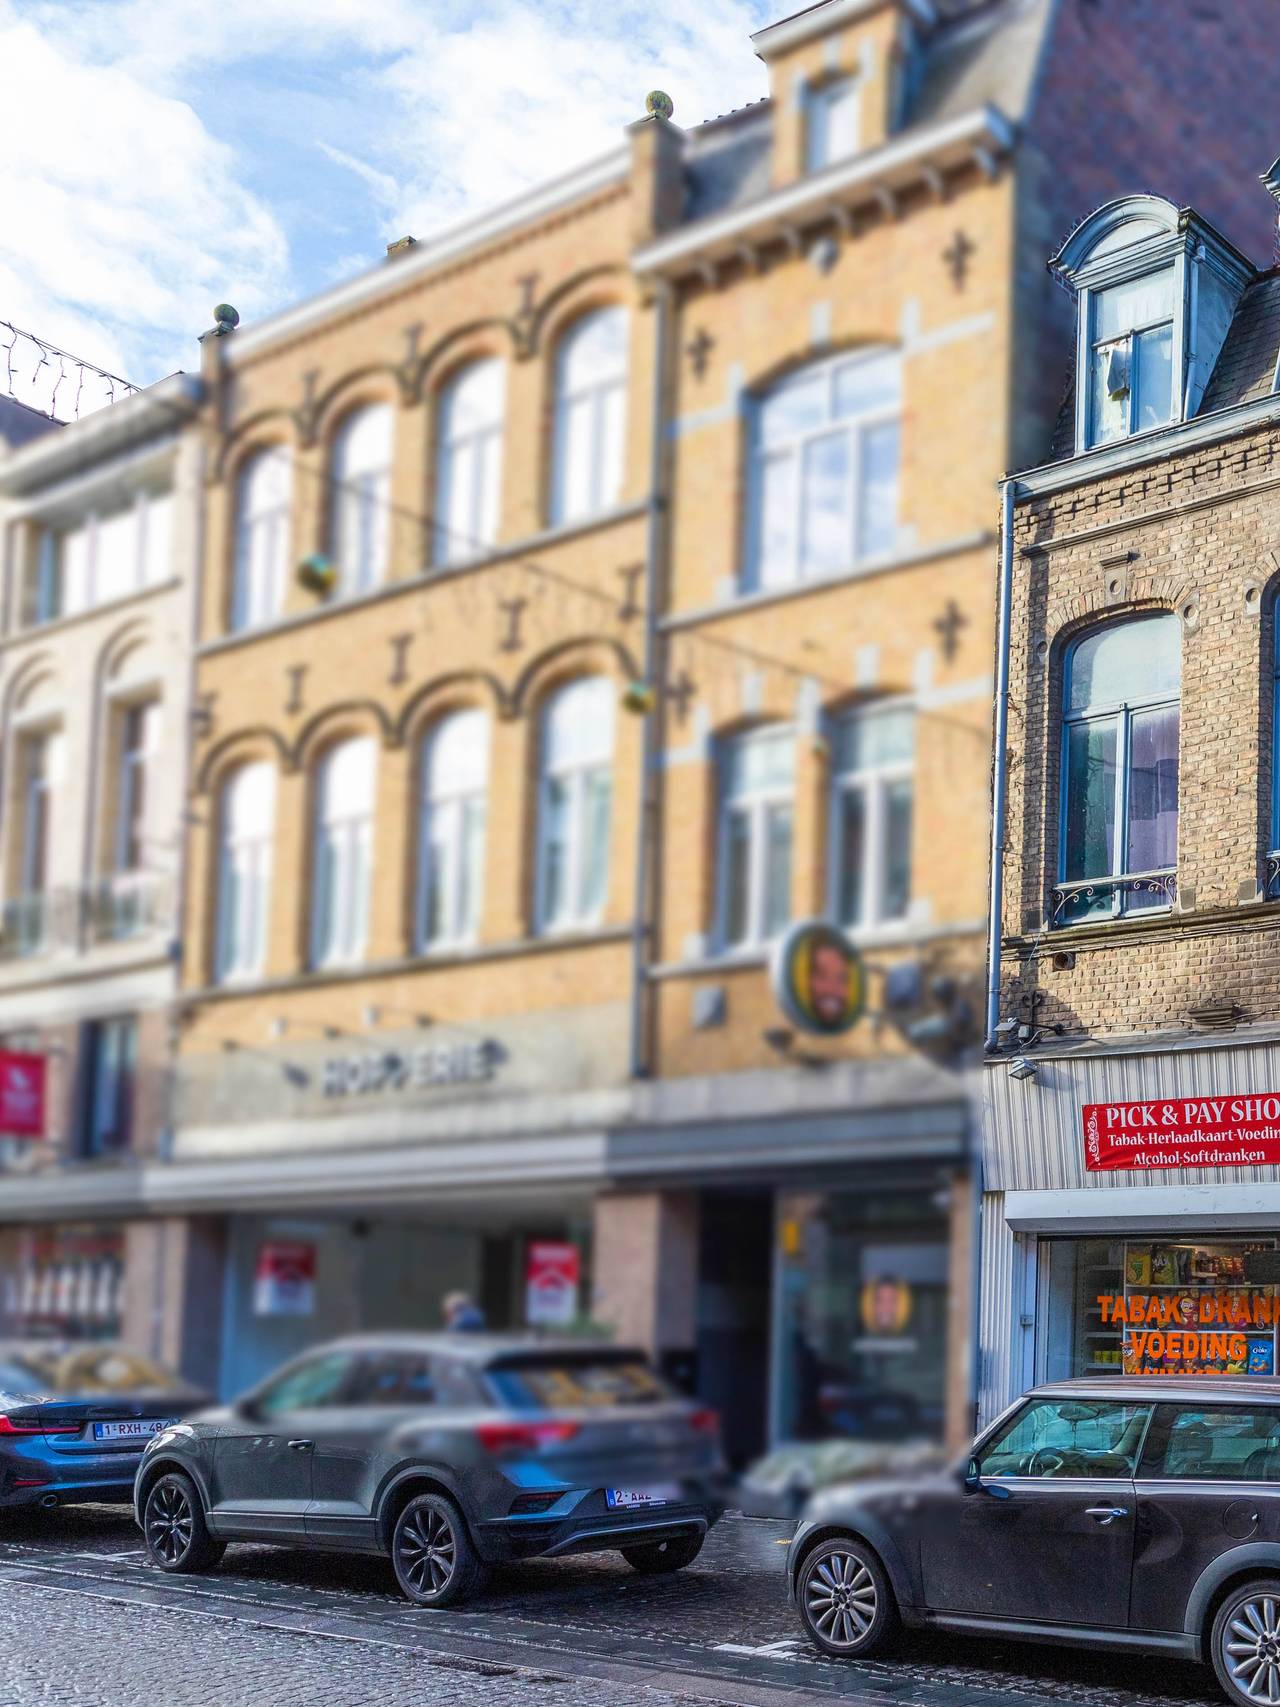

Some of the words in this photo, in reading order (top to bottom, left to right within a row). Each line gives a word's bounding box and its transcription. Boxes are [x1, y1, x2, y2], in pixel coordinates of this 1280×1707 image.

[1106, 1103, 1157, 1129] PICK
[1161, 1104, 1179, 1126] &
[1184, 1101, 1229, 1125] PAY
[1133, 1148, 1266, 1166] Alcohol-Softdranken
[1097, 1295, 1182, 1324] TABAK
[1130, 1332, 1248, 1361] VOEDING
